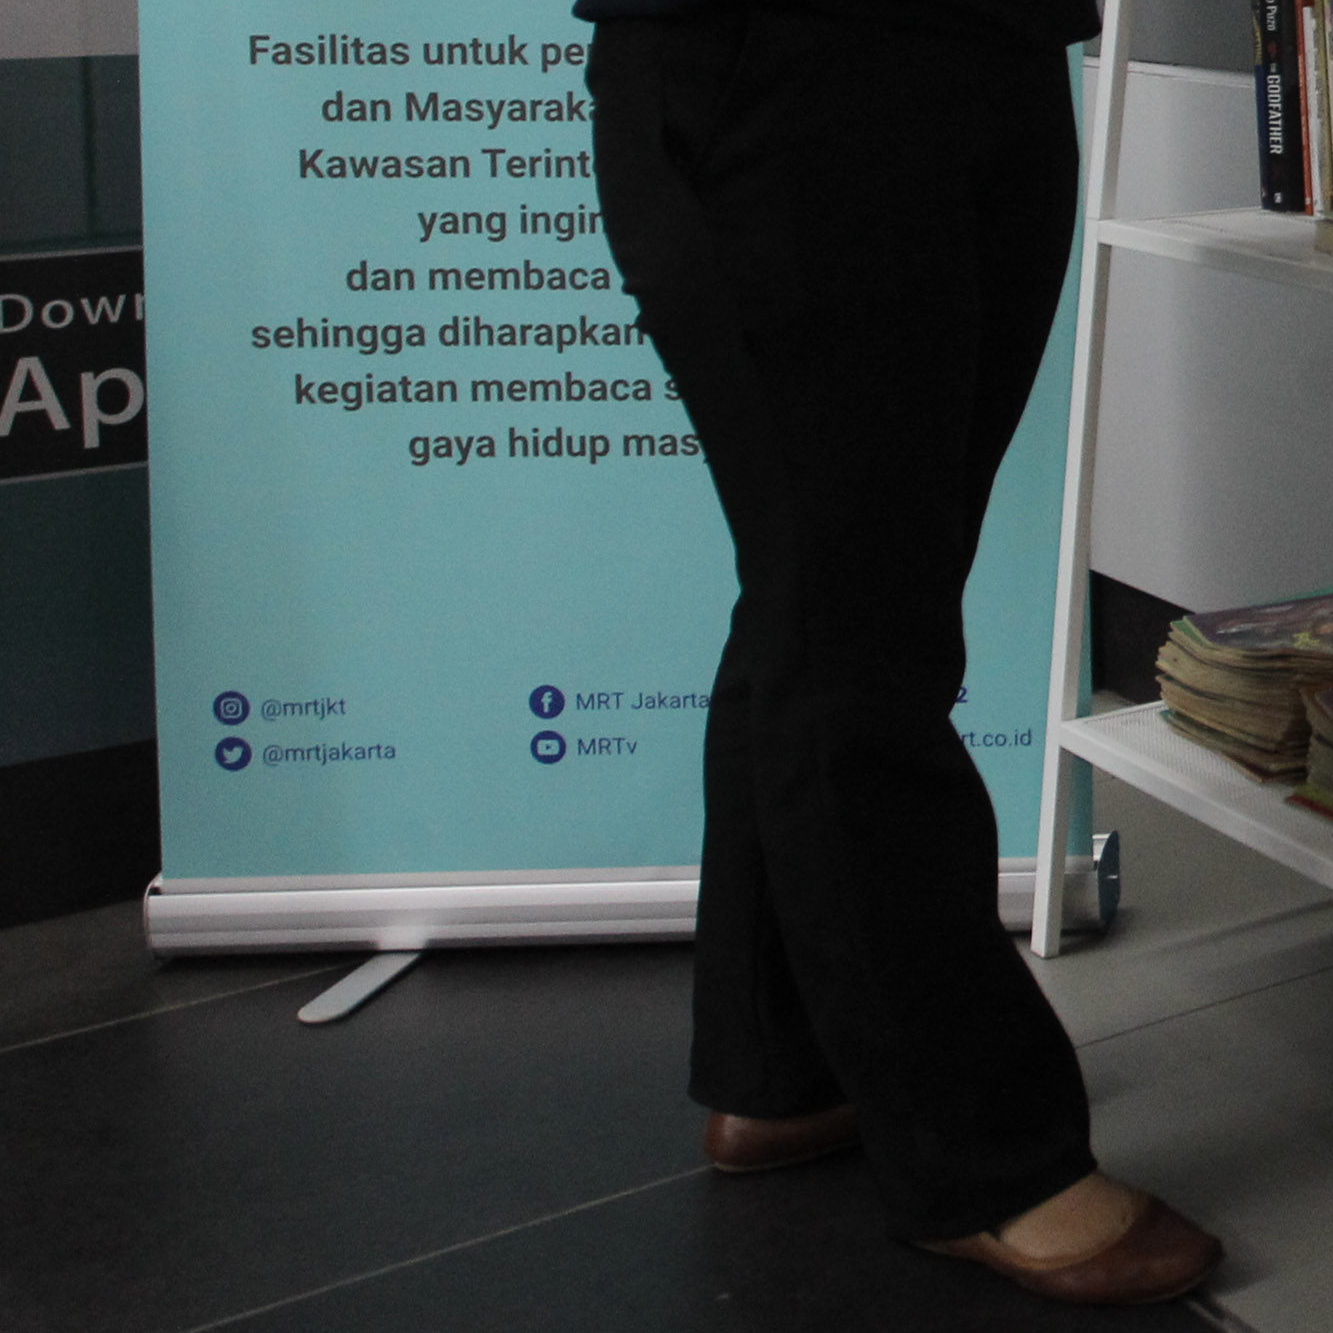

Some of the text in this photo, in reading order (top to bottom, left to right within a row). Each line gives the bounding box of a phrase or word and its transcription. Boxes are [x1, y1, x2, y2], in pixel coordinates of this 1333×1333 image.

[1266, 7, 1275, 32] Puzo
[249, 35, 410, 67] Fasilitas
[423, 36, 530, 67] untuk
[321, 92, 392, 123] dan
[1266, 74, 1282, 155] GODFATHER
[299, 149, 471, 179] Kawasan
[417, 206, 507, 243] yang
[346, 261, 611, 292] dan membaca
[251, 315, 644, 354] sehingga diharapkan
[294, 373, 458, 411] kegiatan
[471, 372, 653, 403] membaca
[408, 433, 497, 466] gaya
[508, 428, 610, 465] hidup
[261, 698, 347, 721] @mrtjkt
[575, 691, 711, 711] MRT Jakarta
[262, 743, 397, 765] @mrtjakarta
[576, 738, 638, 757] MRTv
